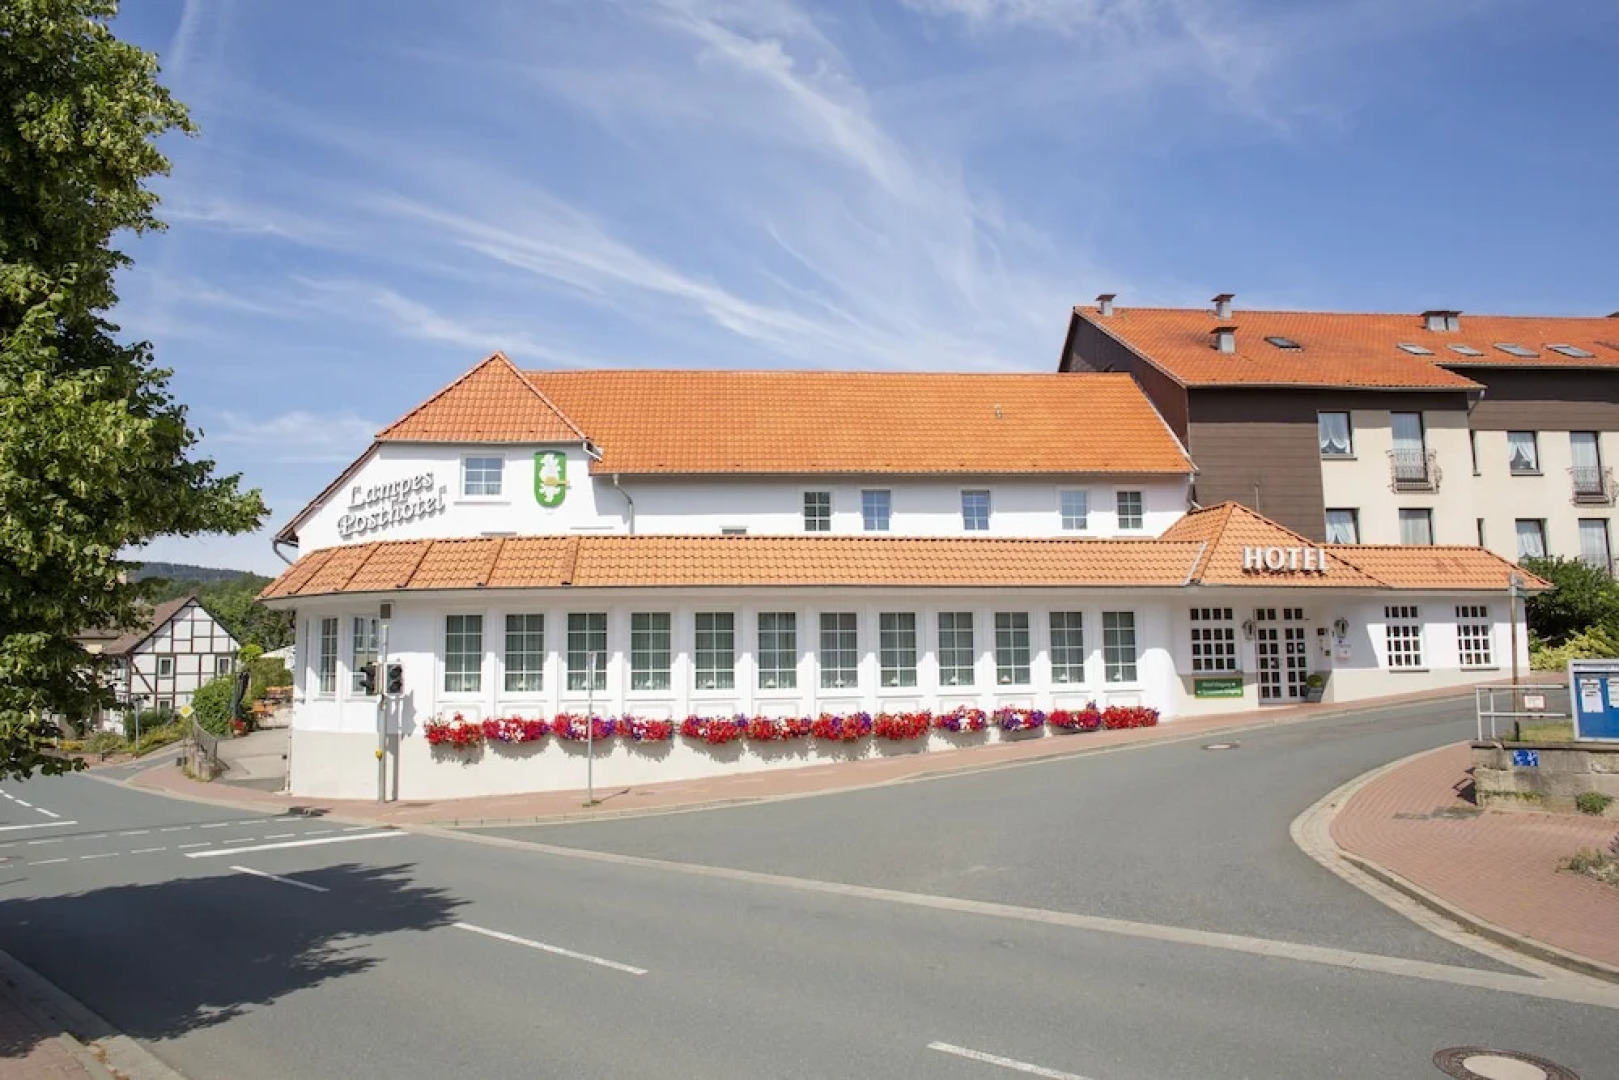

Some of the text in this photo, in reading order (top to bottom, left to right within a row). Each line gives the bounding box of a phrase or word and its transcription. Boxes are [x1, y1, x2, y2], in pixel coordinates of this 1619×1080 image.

[348, 473, 433, 510] Lampes
[338, 485, 446, 538] Posthotel
[1244, 546, 1329, 571] HOTEL
